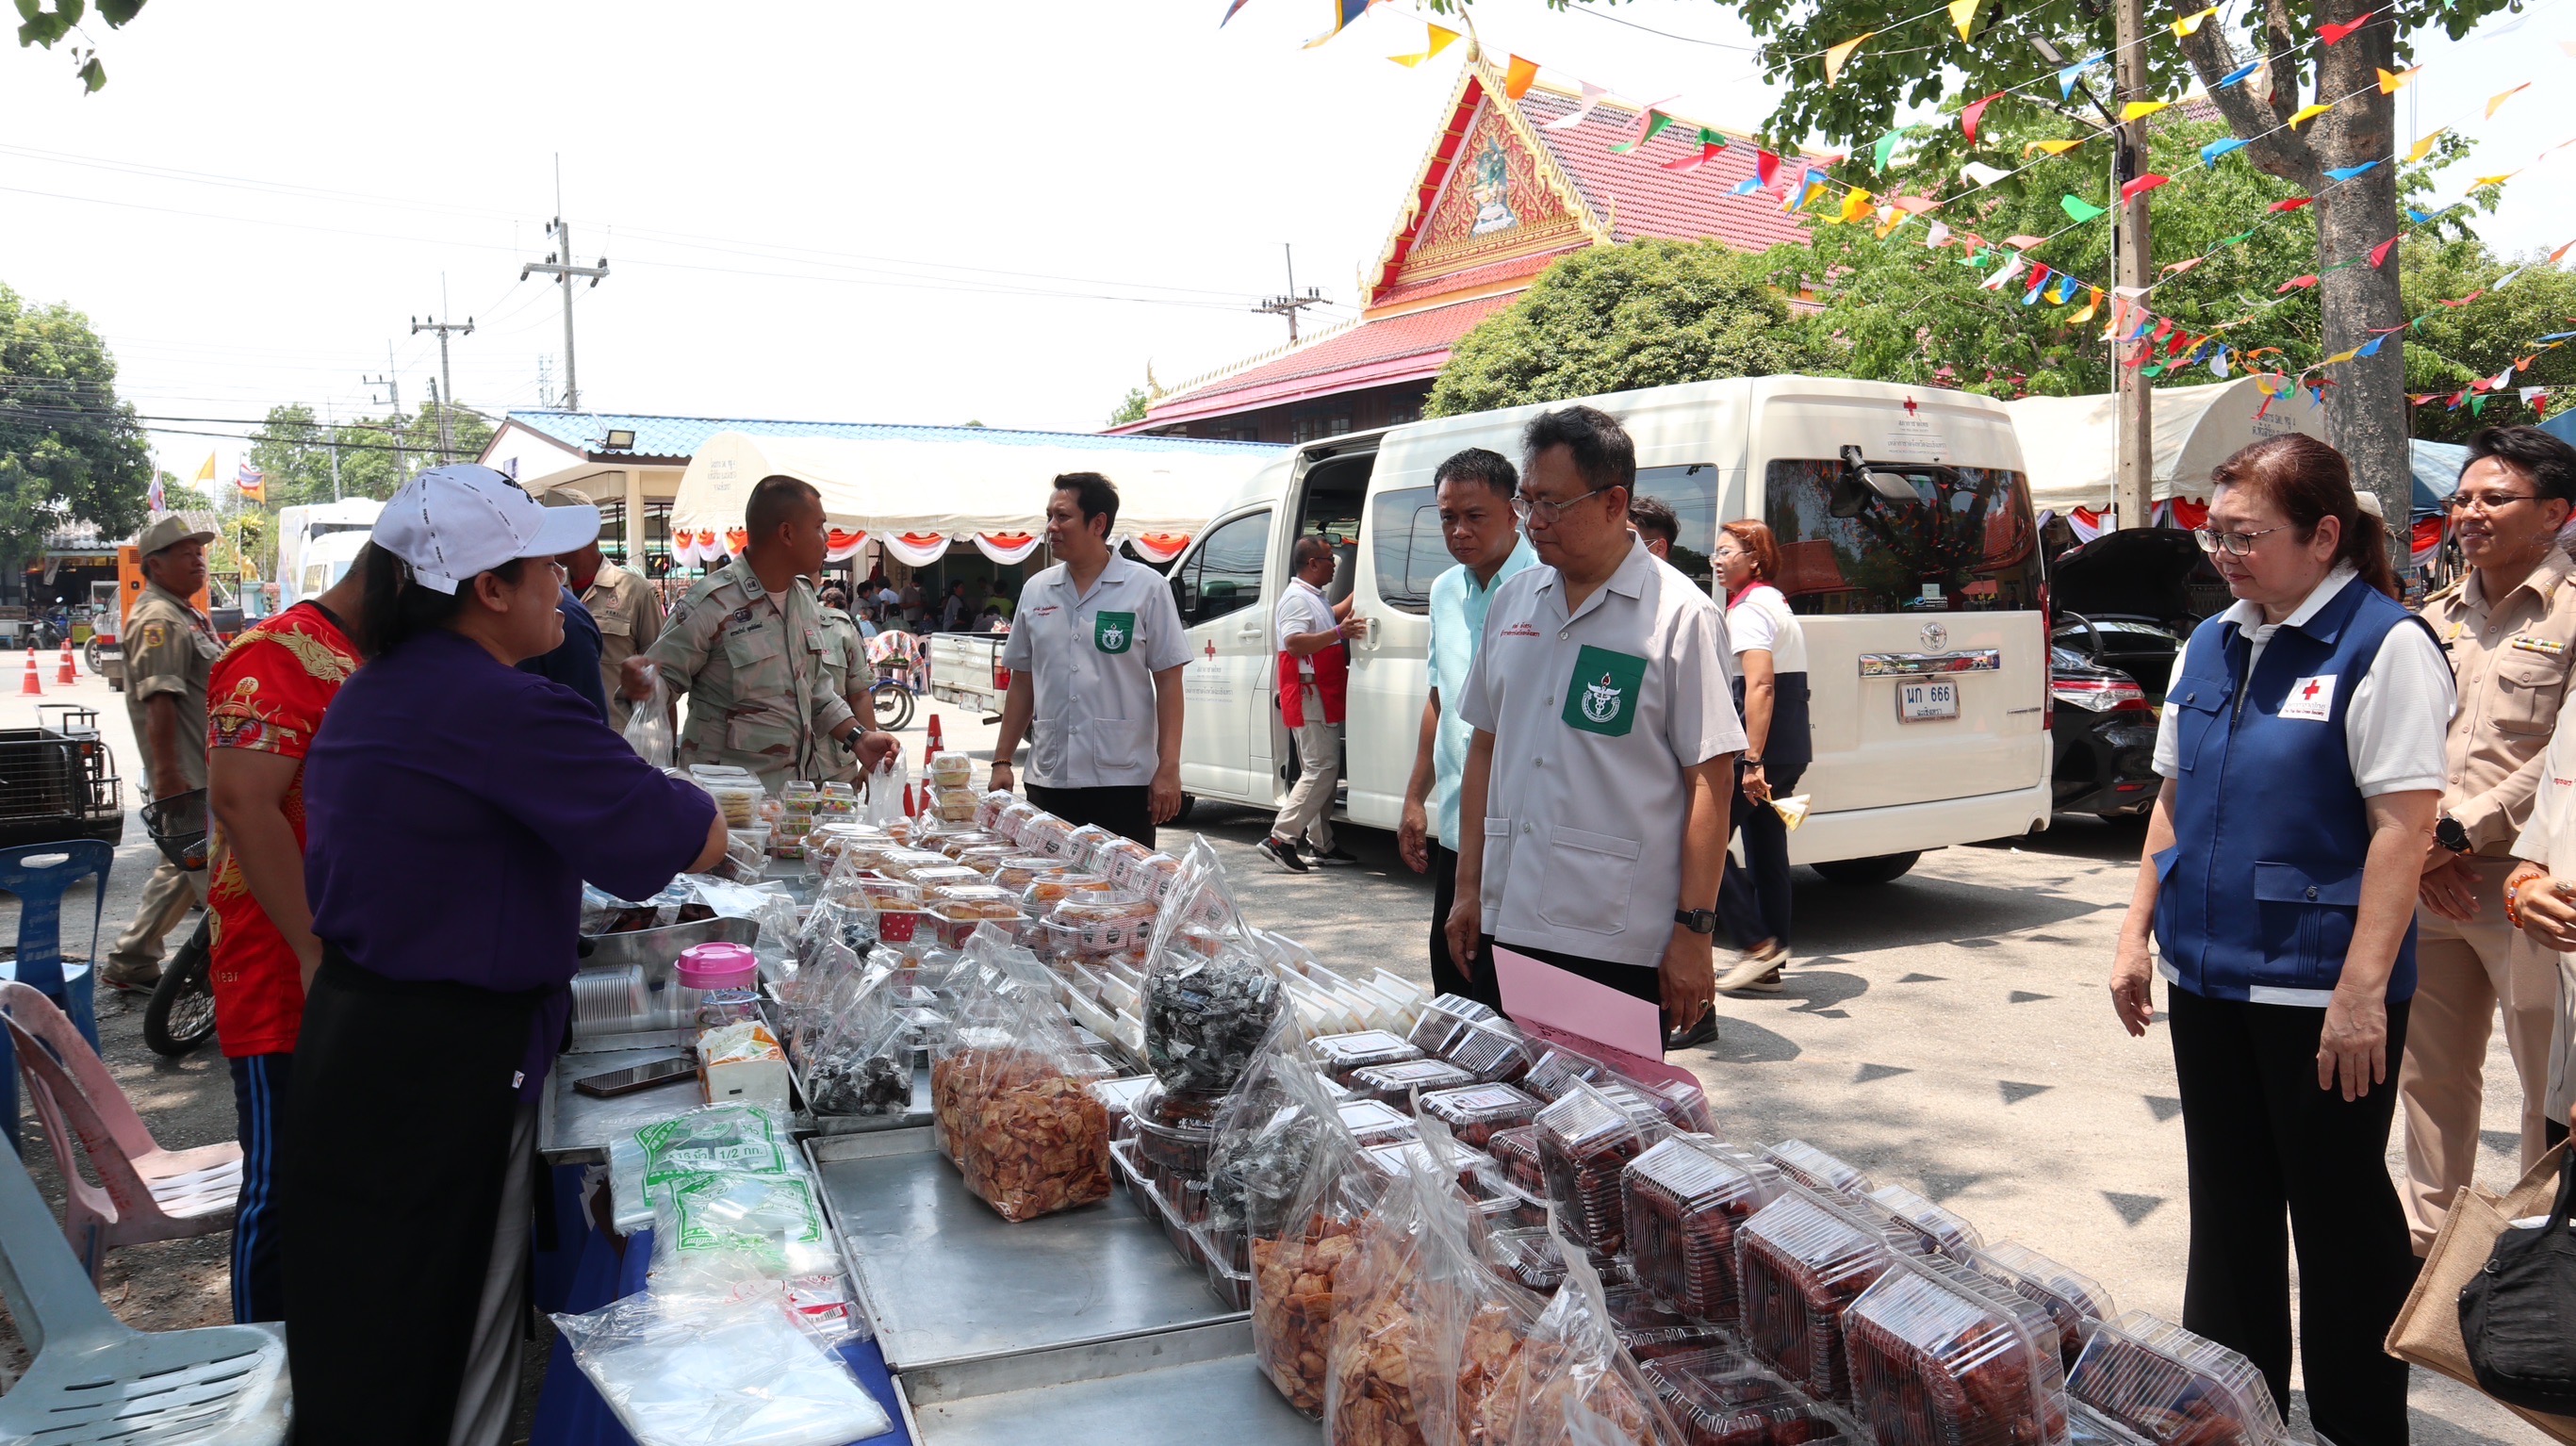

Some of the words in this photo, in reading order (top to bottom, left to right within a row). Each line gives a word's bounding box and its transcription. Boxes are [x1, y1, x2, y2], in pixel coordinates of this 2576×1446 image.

[239, 679, 256, 694] 龍
[1907, 687, 1923, 704] นก
[1930, 686, 1950, 702] 666
[1916, 706, 1943, 716] ฉะเชิงเทรา
[719, 1147, 739, 1159] 1/2
[744, 1147, 763, 1156] กก.
